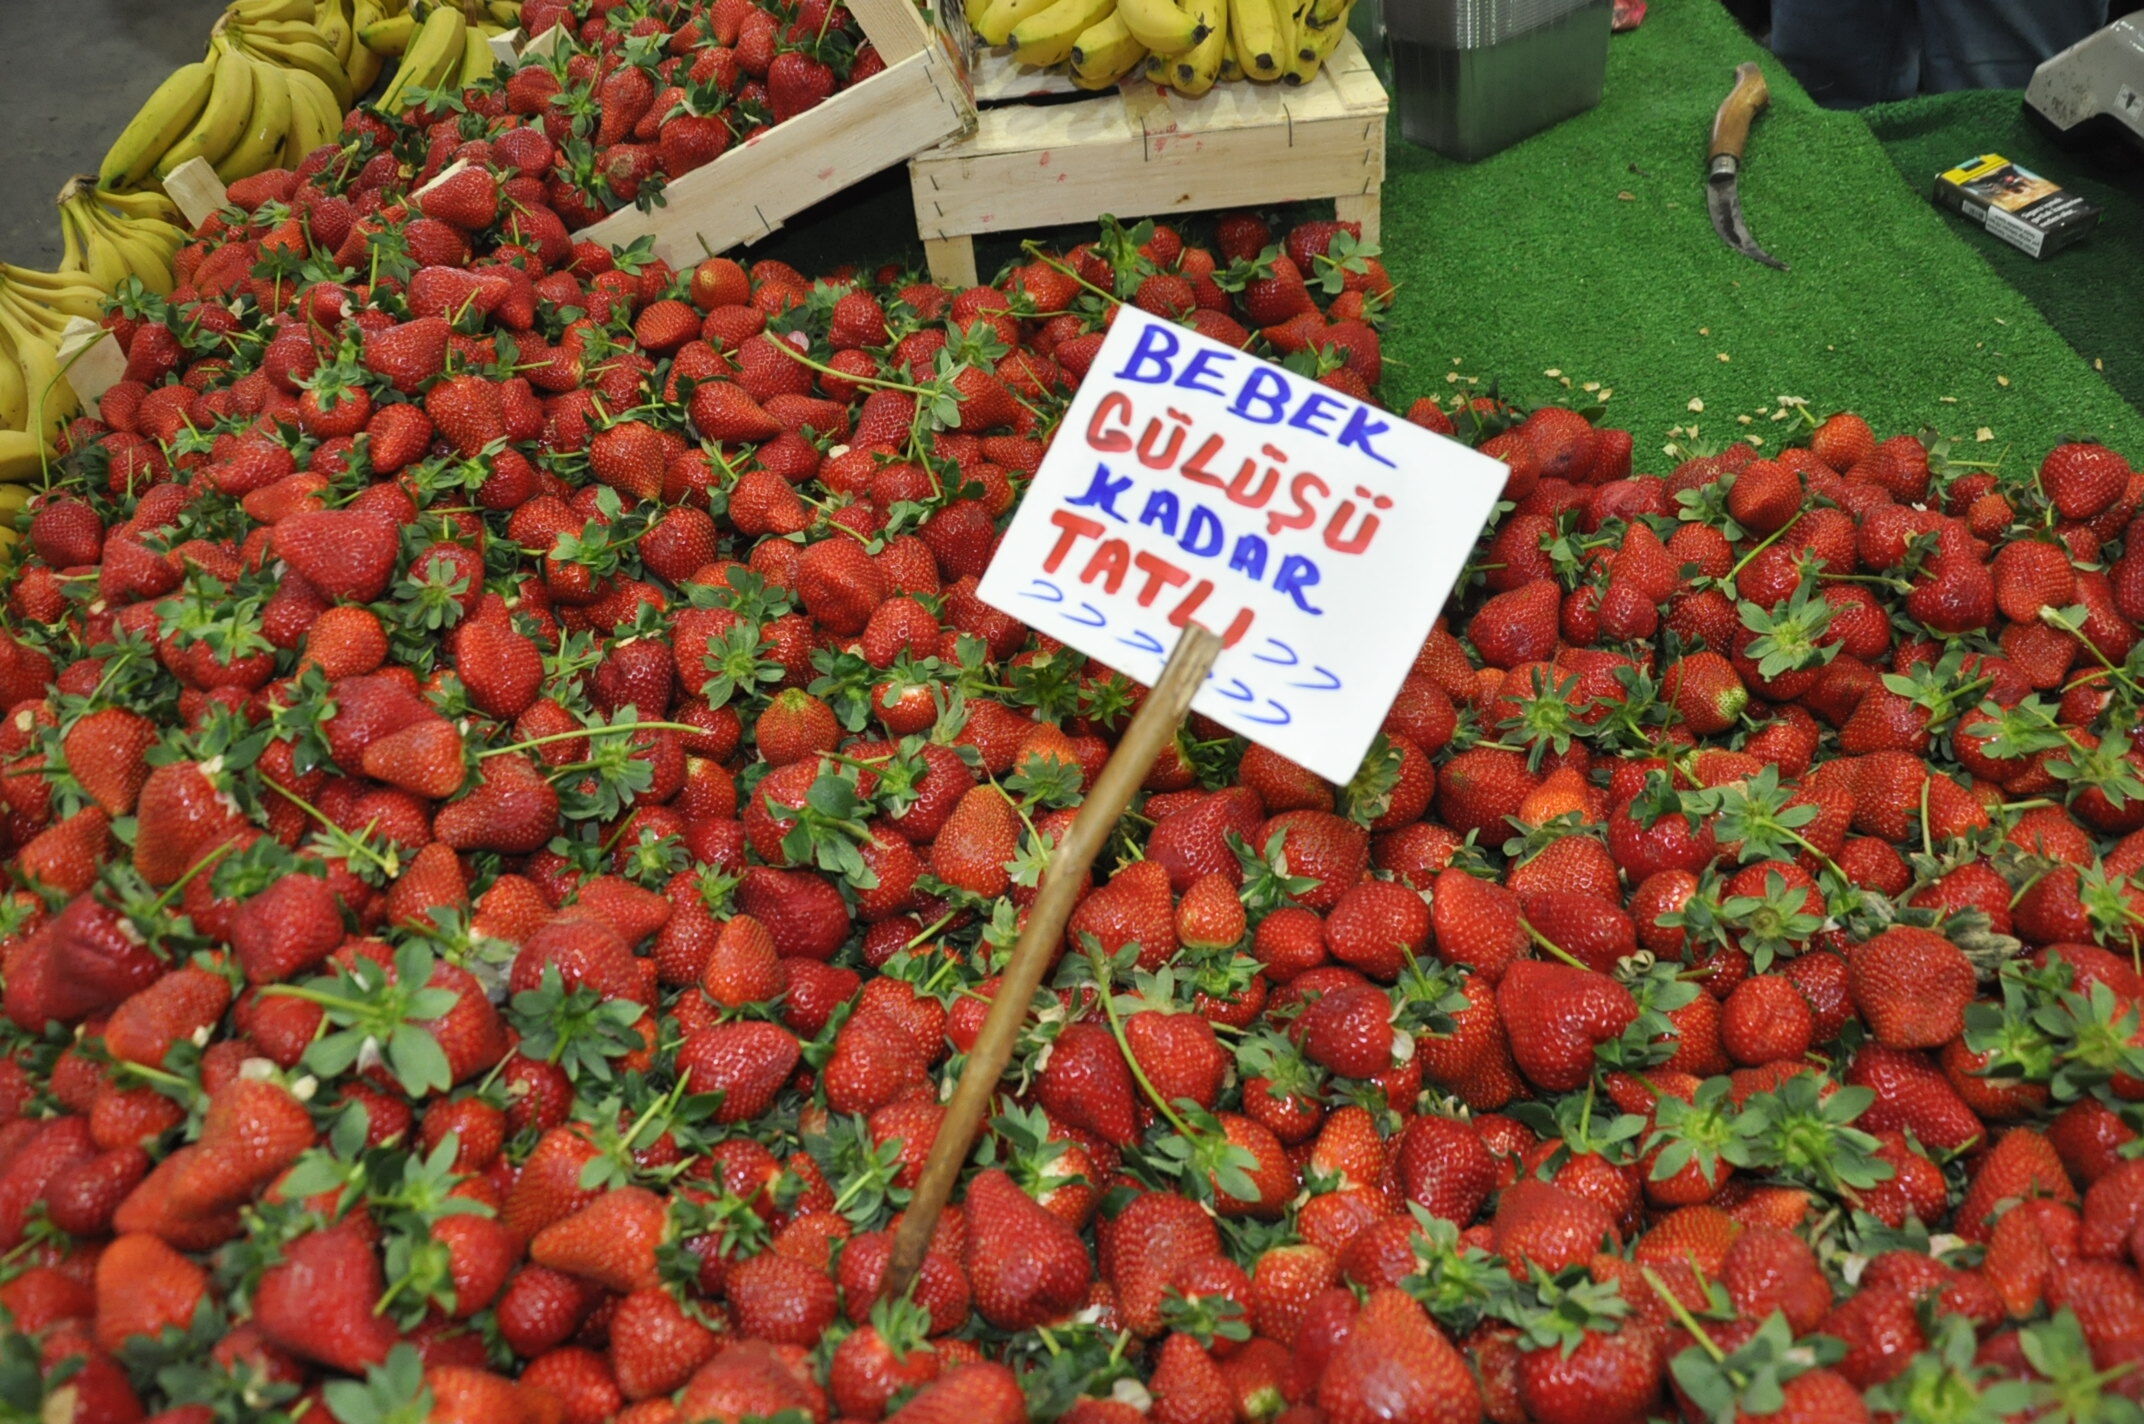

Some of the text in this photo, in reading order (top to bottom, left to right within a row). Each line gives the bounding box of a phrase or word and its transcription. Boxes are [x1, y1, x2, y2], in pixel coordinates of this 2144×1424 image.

[1113, 323, 1398, 470] BEBEK
[1064, 462, 1324, 617] KADAR
[1085, 391, 1394, 556] GÜLÜŞÜ
[1041, 509, 1256, 651] TATLI
